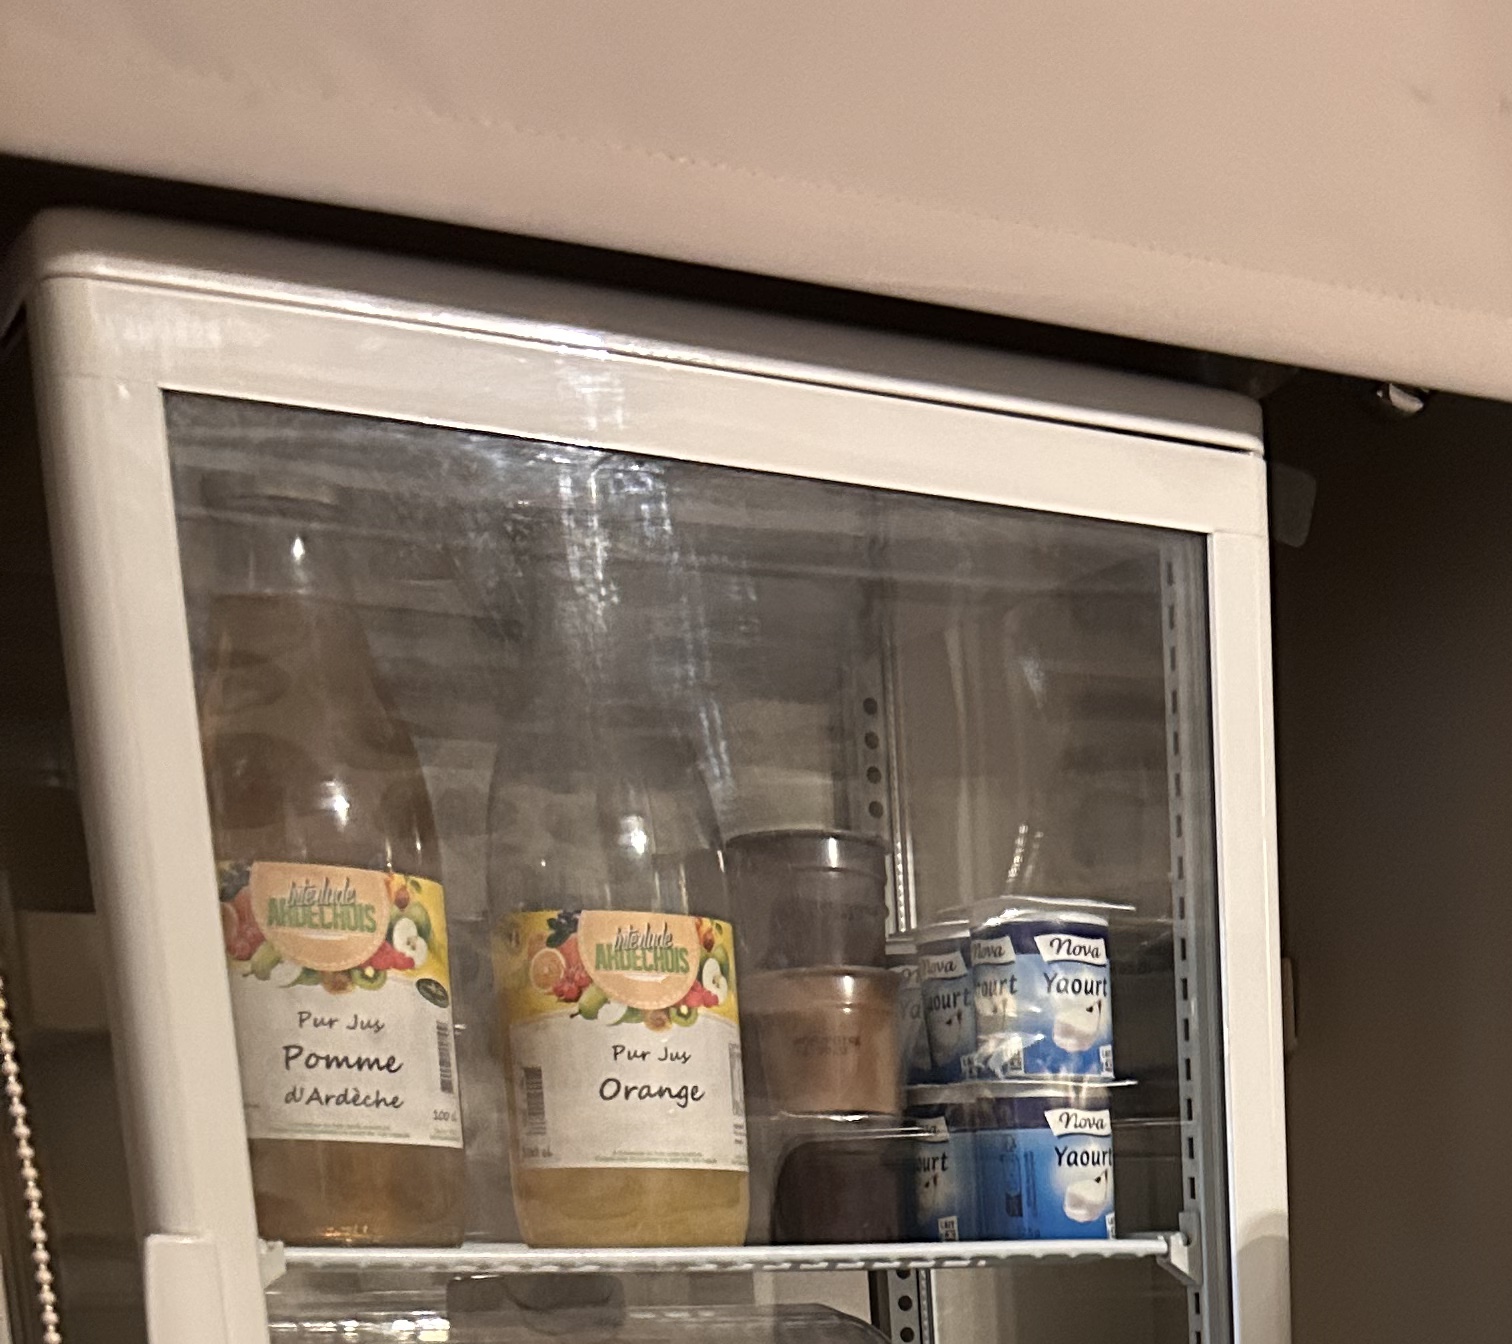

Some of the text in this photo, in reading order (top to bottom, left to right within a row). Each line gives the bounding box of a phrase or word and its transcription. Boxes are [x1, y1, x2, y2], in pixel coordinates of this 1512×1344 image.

[1050, 937, 1102, 959] Nova
[976, 974, 1018, 996] ourt
[1043, 972, 1108, 997] Yaourt
[298, 1010, 385, 1034] Pur Jus
[282, 1044, 404, 1073] Pomme
[611, 1044, 692, 1064] Pur Jus
[284, 1086, 405, 1110] d'Ardèche
[599, 1077, 706, 1109] Orange
[1059, 1111, 1107, 1131] Nova
